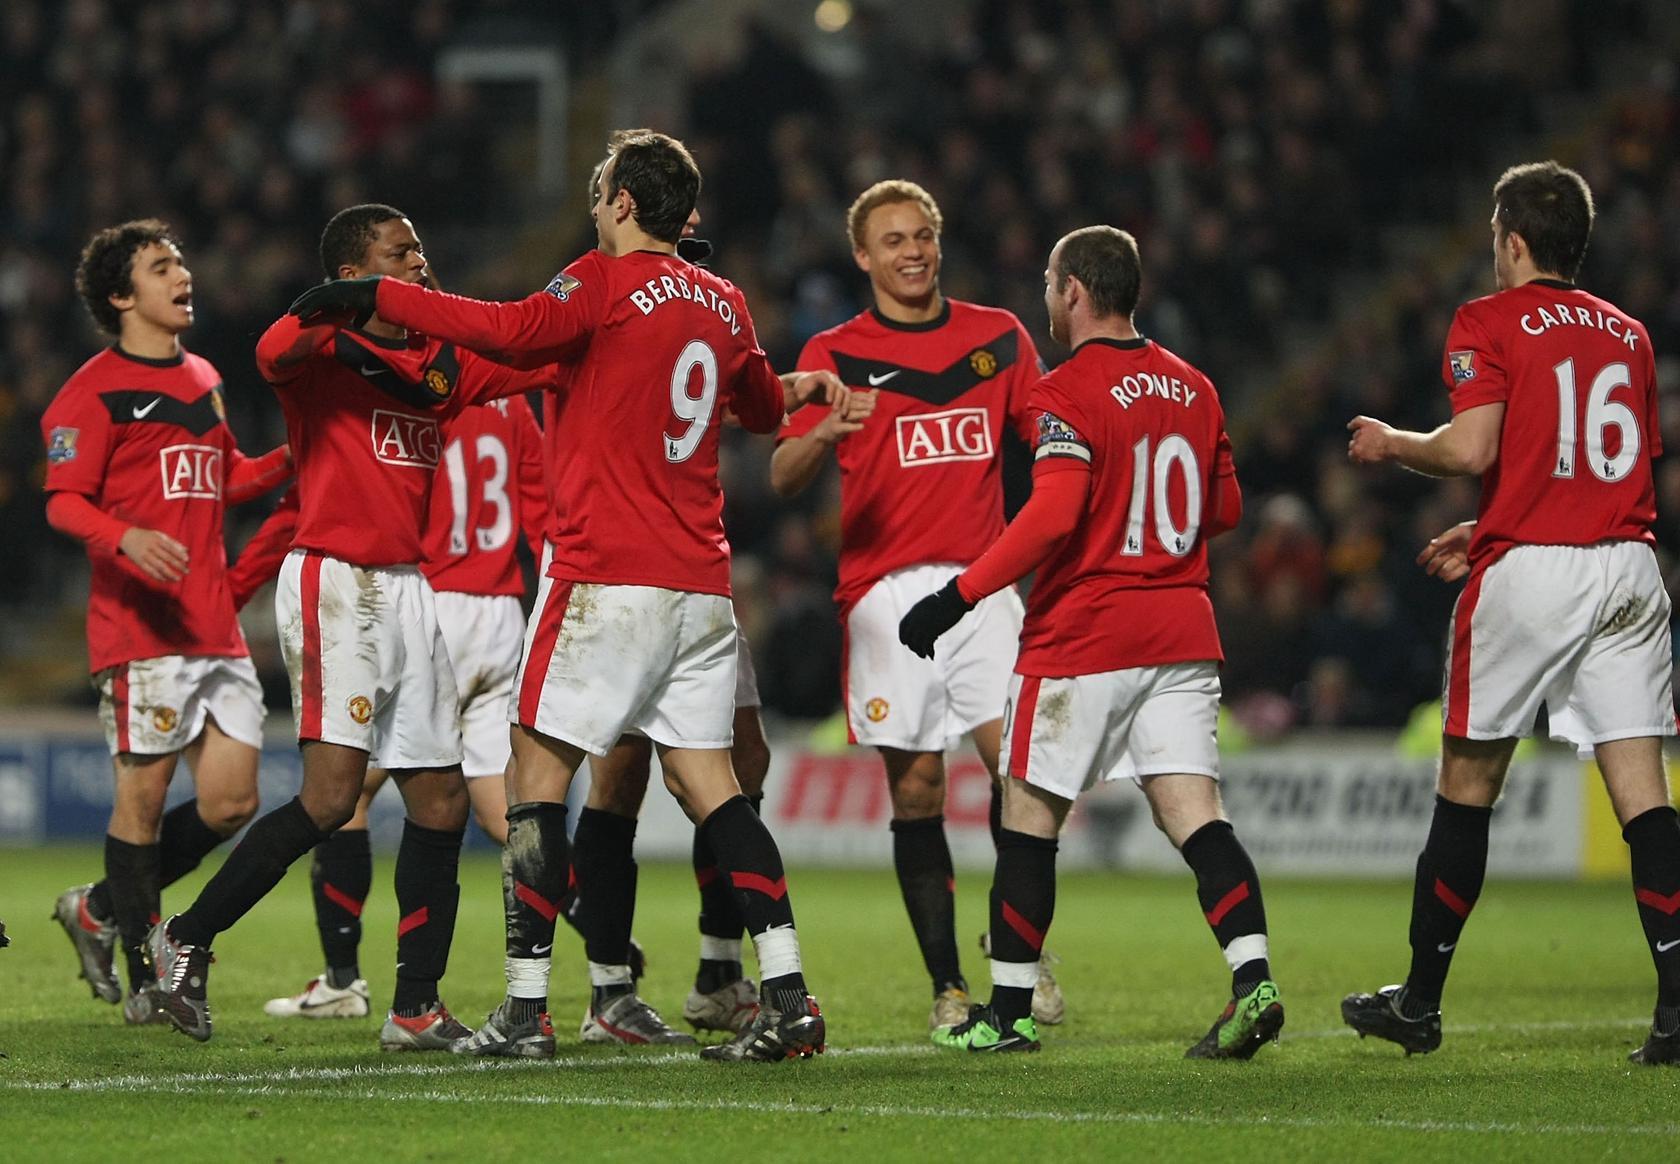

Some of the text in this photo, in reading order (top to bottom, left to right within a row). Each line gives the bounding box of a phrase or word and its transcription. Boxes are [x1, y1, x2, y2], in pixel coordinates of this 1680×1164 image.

[1520, 303, 1639, 351] CARRICK
[662, 338, 719, 464] 9
[1109, 372, 1197, 410] ROONEY
[1552, 356, 1642, 483] 16
[378, 417, 439, 463] AIG
[905, 413, 985, 460] AIG
[445, 434, 513, 555] 13
[1120, 432, 1203, 557] 10
